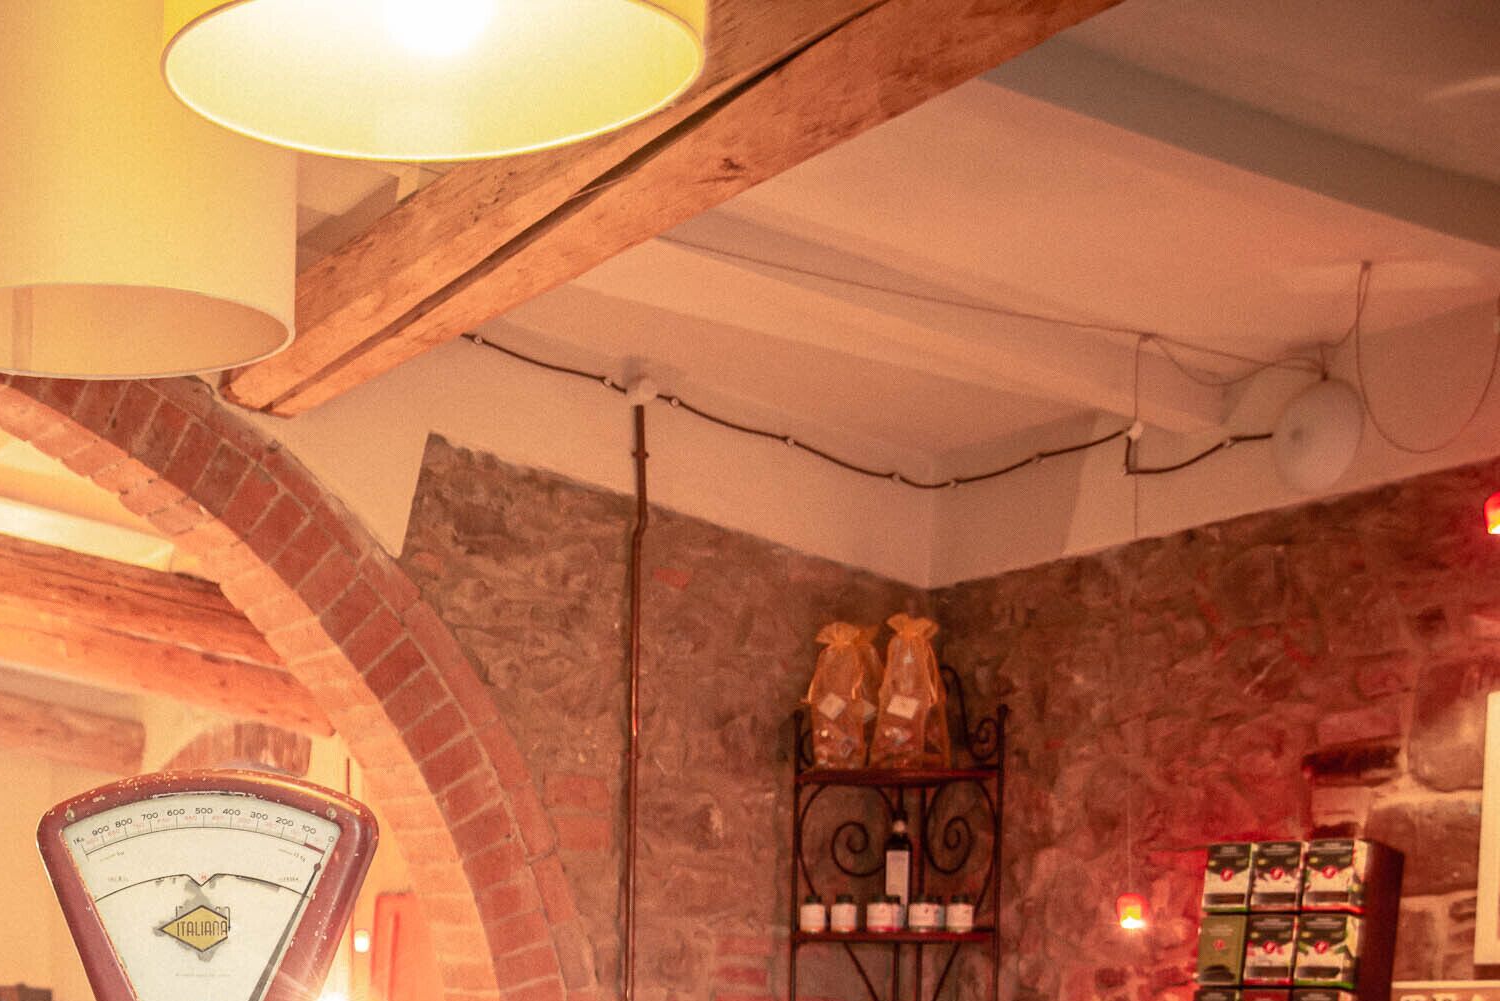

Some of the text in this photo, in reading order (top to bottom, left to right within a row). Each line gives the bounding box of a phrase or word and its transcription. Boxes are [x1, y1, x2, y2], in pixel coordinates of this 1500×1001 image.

[91, 825, 110, 837] 900
[115, 817, 133, 828] 800
[141, 812, 159, 821] 700
[166, 808, 185, 817] 600
[195, 807, 213, 815] 500
[222, 808, 241, 816] 400
[250, 811, 269, 821] 300
[275, 816, 294, 827] 200
[301, 824, 317, 835] 100
[176, 920, 228, 937] ITALIANA
